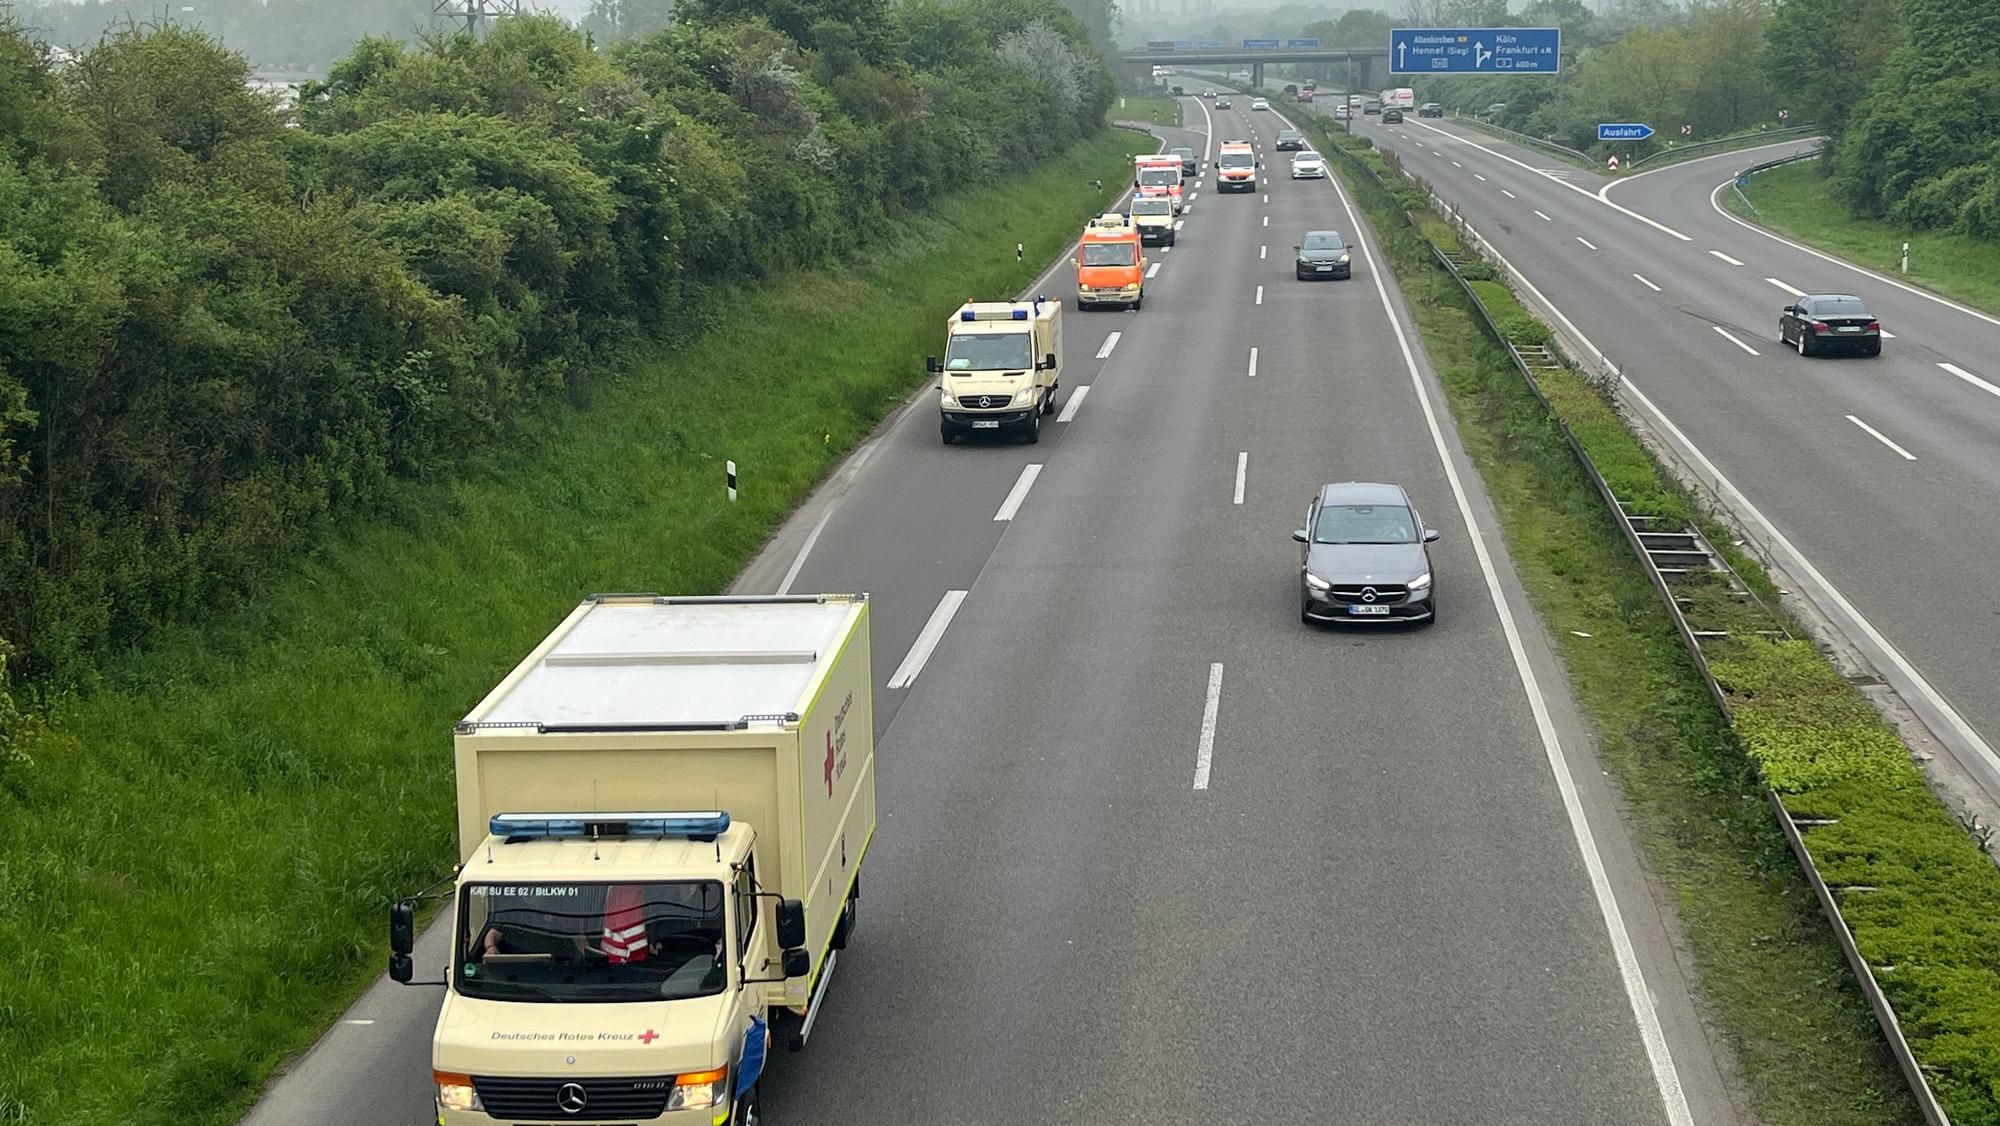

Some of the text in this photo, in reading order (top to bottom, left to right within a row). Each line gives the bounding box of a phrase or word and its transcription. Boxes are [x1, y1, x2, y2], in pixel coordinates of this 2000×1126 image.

[1496, 34, 1517, 43] Köln
[1412, 46, 1469, 56] Hennef (Sieg)
[1496, 45, 1538, 54] Frankfurt
[1603, 128, 1642, 137] Ausfahrt
[469, 886, 488, 896] KAT
[489, 886, 502, 896] SU
[503, 886, 517, 896] EE
[518, 886, 529, 896] 02
[529, 886, 534, 896] /
[568, 887, 579, 896] 01
[491, 1031, 634, 1041] Deutsches Rotes Kreuz
